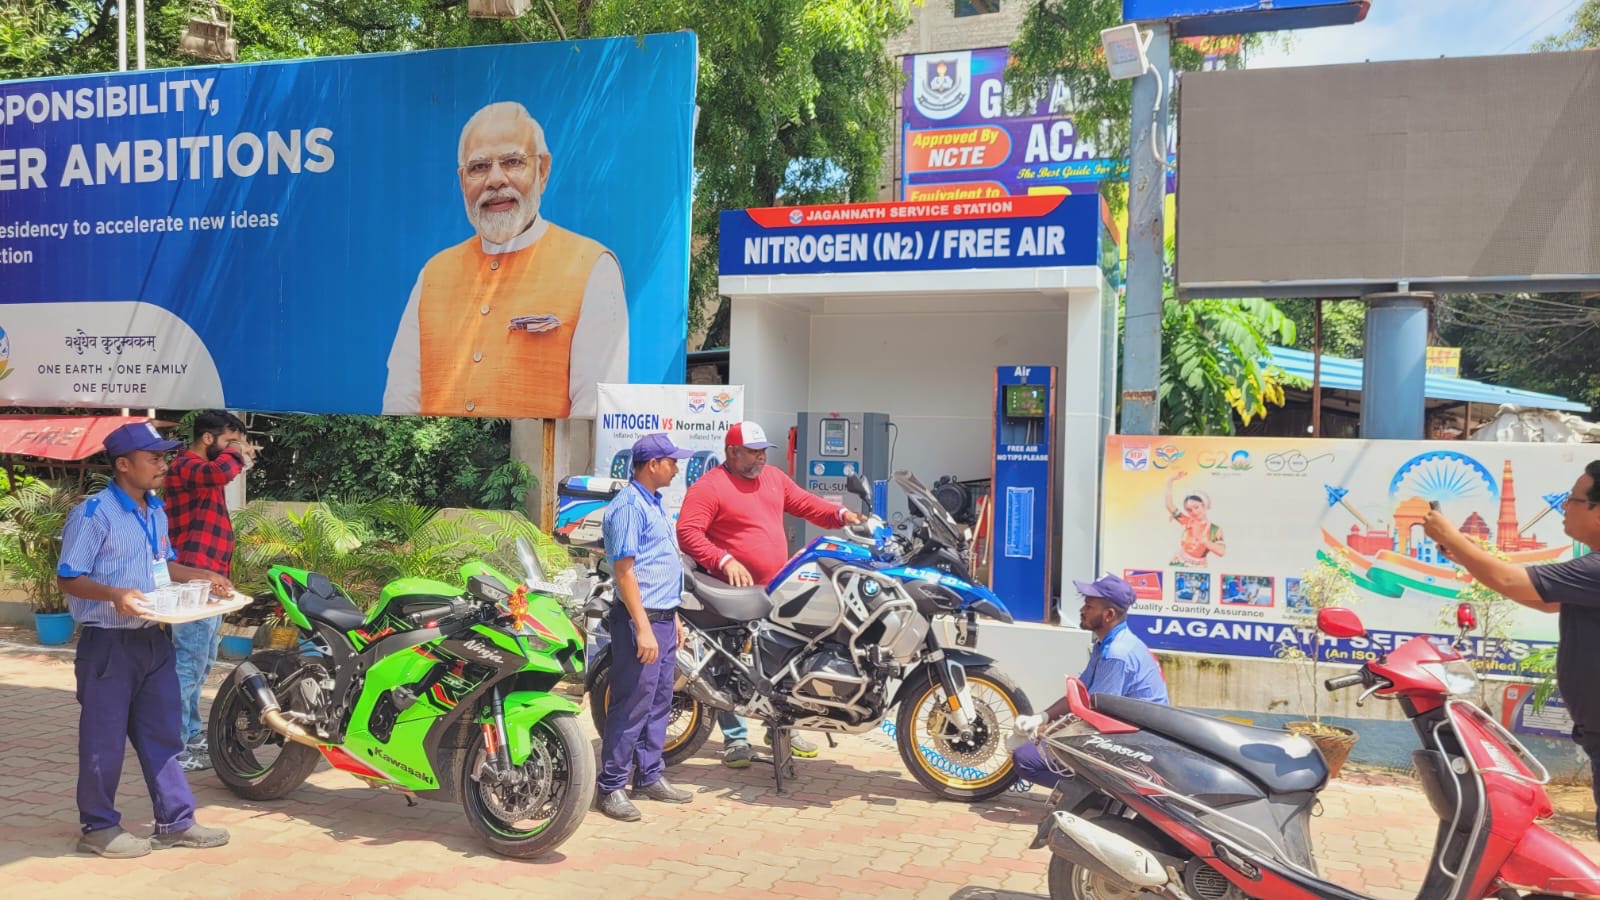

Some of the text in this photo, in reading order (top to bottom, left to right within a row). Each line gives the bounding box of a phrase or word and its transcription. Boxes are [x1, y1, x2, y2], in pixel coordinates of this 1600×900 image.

[0, 78, 219, 127] PONSIBILITY,
[912, 128, 999, 149] Approved By
[60, 127, 335, 187] AMBITIONS
[928, 145, 986, 168] NCTE
[73, 219, 91, 236] to
[95, 215, 183, 234] accelerate
[189, 214, 225, 231] new
[230, 210, 279, 230] ideas
[806, 201, 1013, 222] JAGANNATH SERVICE STATION
[0, 246, 33, 264] tion
[744, 233, 869, 265] NITROGEN
[873, 231, 924, 262] (N2)
[943, 227, 1011, 259] FREE
[1016, 225, 1066, 257] AIR
[37, 364, 188, 375] ONE EARTH ONE FAMILY
[1014, 366, 1031, 377] Air
[73, 383, 147, 394] ONE FUTURE
[603, 414, 659, 430] NITROGEN
[662, 418, 673, 430] VS
[676, 420, 715, 431] Normal
[1131, 601, 1163, 612] Quality
[1171, 605, 1211, 615] Quantity
[1213, 607, 1264, 618] Assurance
[1147, 618, 1338, 646] JAGANNATH
[463, 639, 504, 664] Ninja
[1081, 735, 1154, 762] Pleasure
[374, 746, 434, 785] Kawasaki
